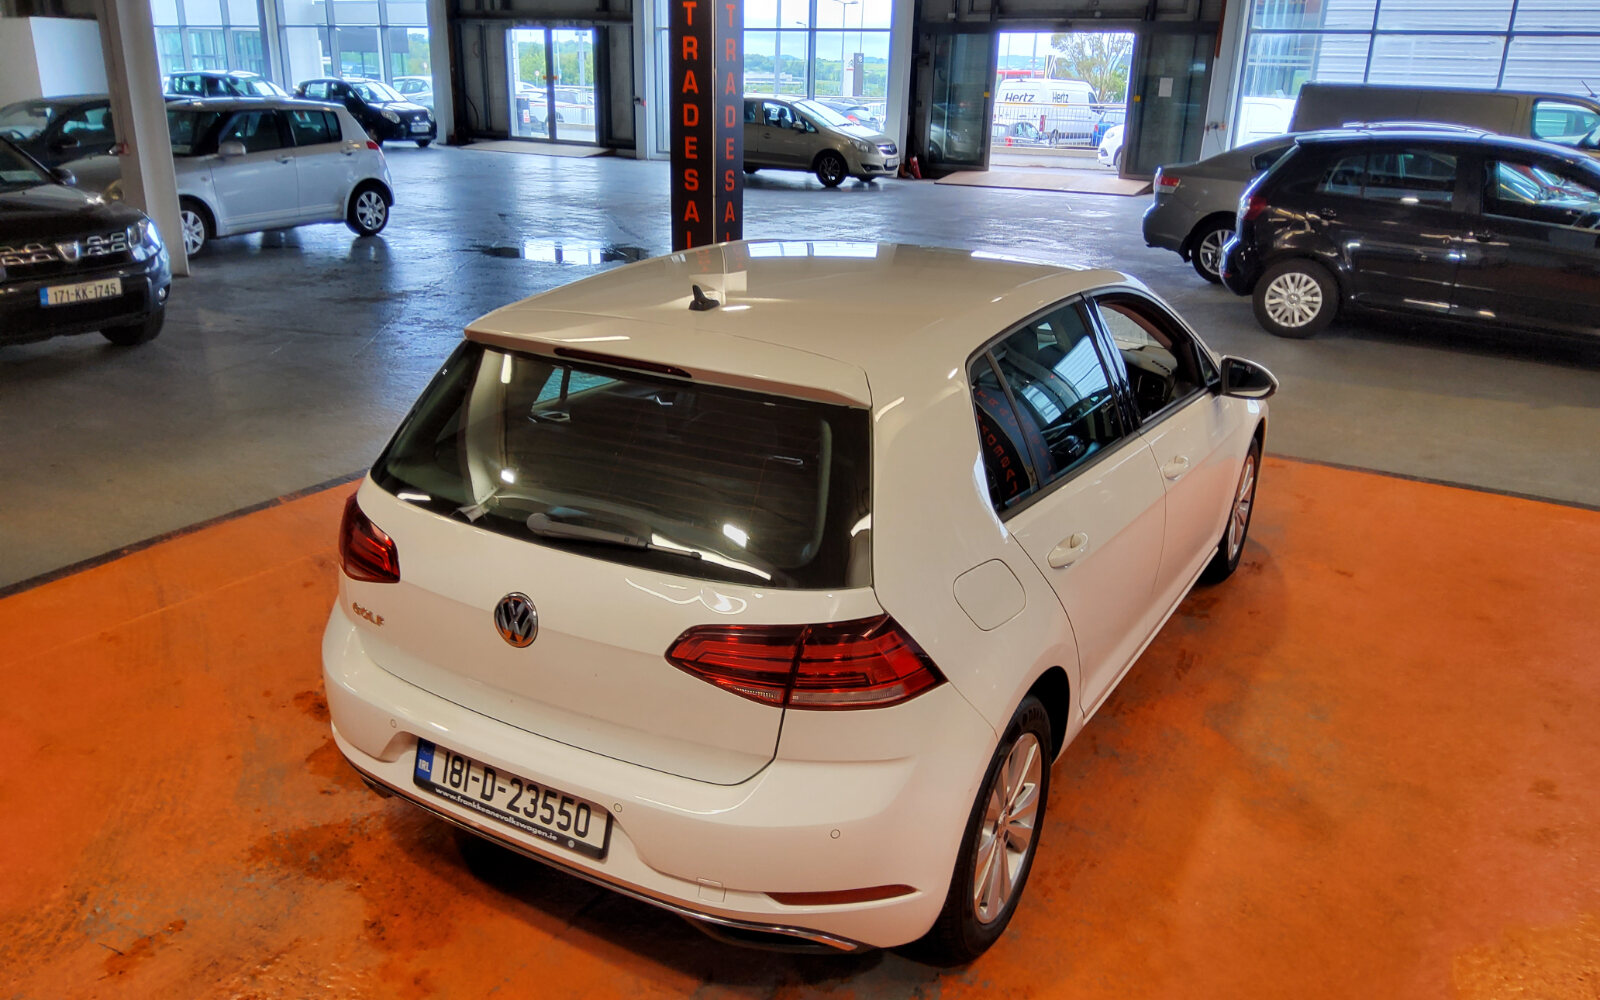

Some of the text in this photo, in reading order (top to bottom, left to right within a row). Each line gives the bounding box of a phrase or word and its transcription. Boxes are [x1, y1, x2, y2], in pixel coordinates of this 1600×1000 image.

[1004, 92, 1035, 103] Hertz
[1052, 91, 1069, 103] Hertz
[53, 283, 116, 303] 171-KK-1745
[352, 602, 385, 627] GOLF
[417, 758, 430, 773] IRL
[442, 751, 592, 839] 181-D-23550
[435, 787, 558, 841] www.frankkeanevolkswagen.ie
